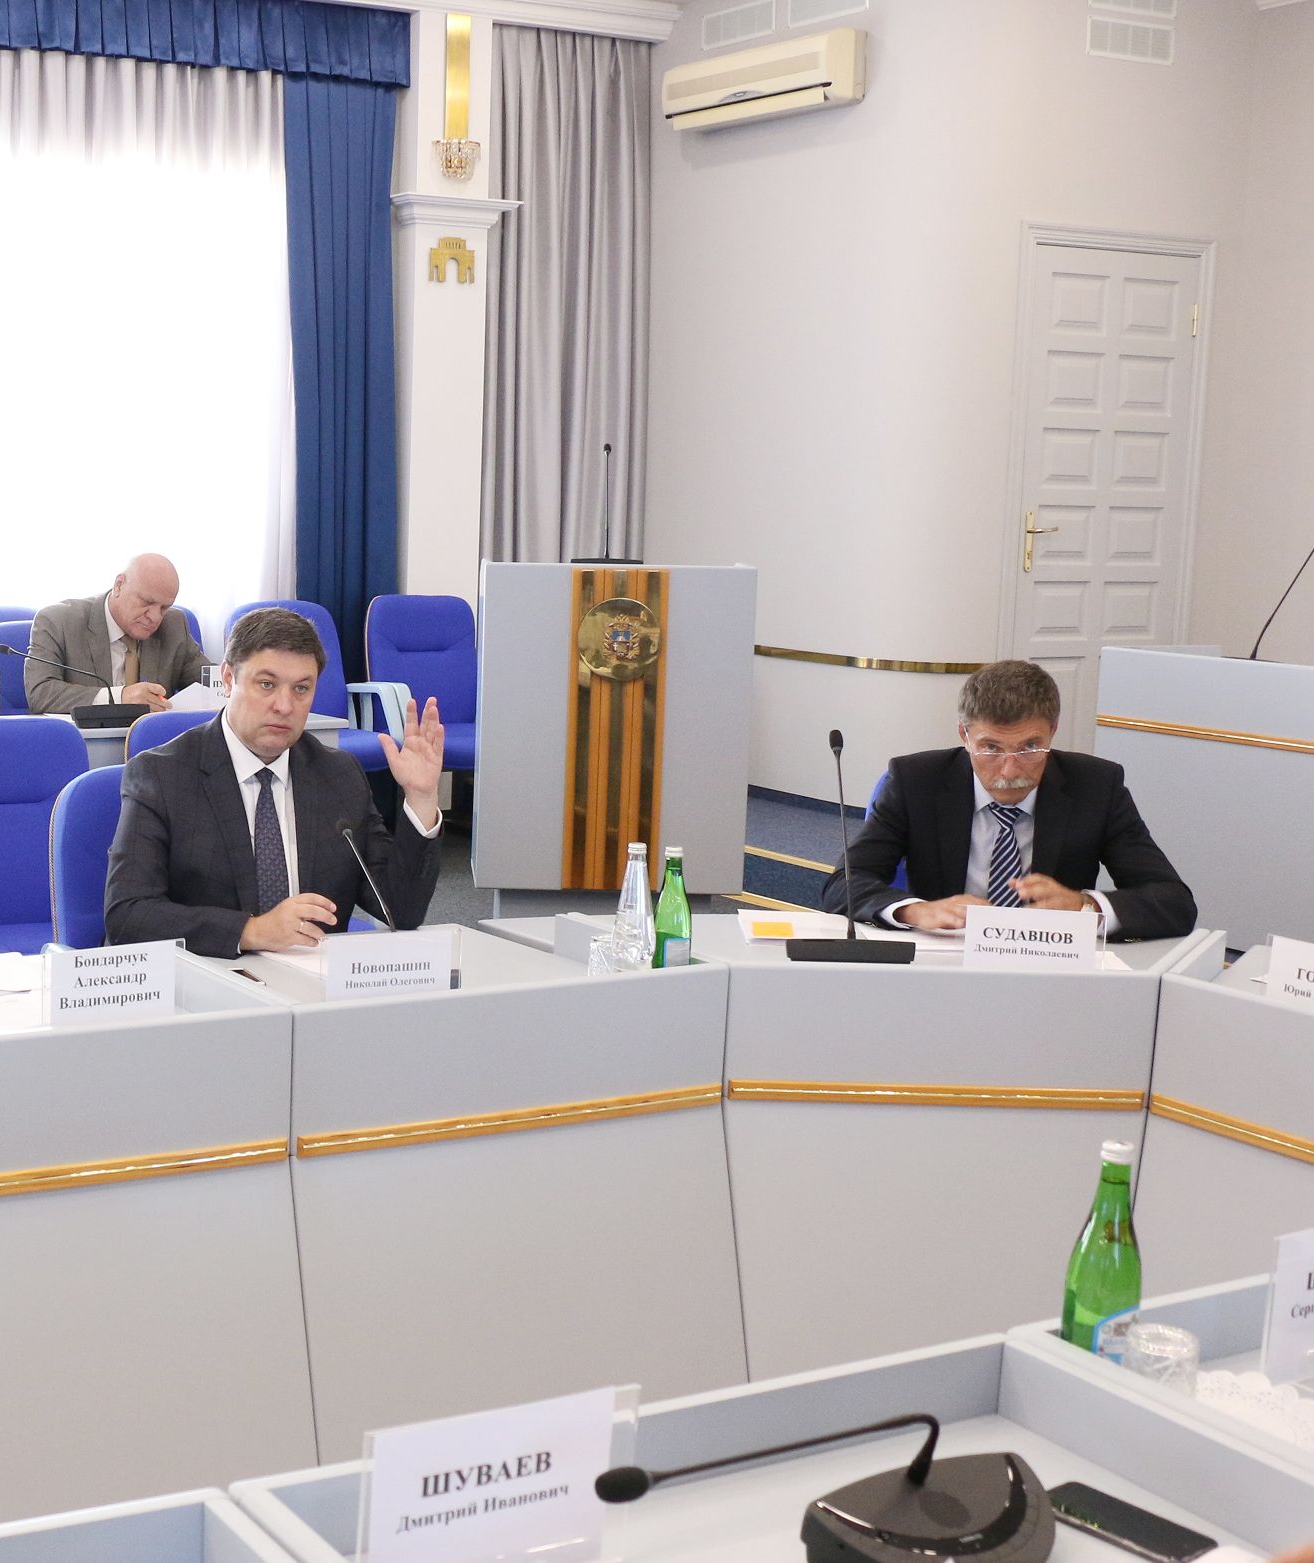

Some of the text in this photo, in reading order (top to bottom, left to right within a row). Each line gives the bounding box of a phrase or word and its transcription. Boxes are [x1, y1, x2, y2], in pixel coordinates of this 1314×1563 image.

[983, 927, 1074, 945] СУДАВЦОВ
[974, 944, 1079, 959] Дмитрий Николаевич
[74, 952, 148, 968] Бондарчук
[351, 962, 431, 975] Новопашин
[74, 972, 147, 988] Александр
[345, 977, 435, 989] Николай Олегович
[1284, 983, 1312, 998] Юрий
[60, 990, 161, 1009] Владимирович
[421, 1451, 553, 1498] ШУВАЕВ
[396, 1485, 569, 1534] Дмитрий Иванович
